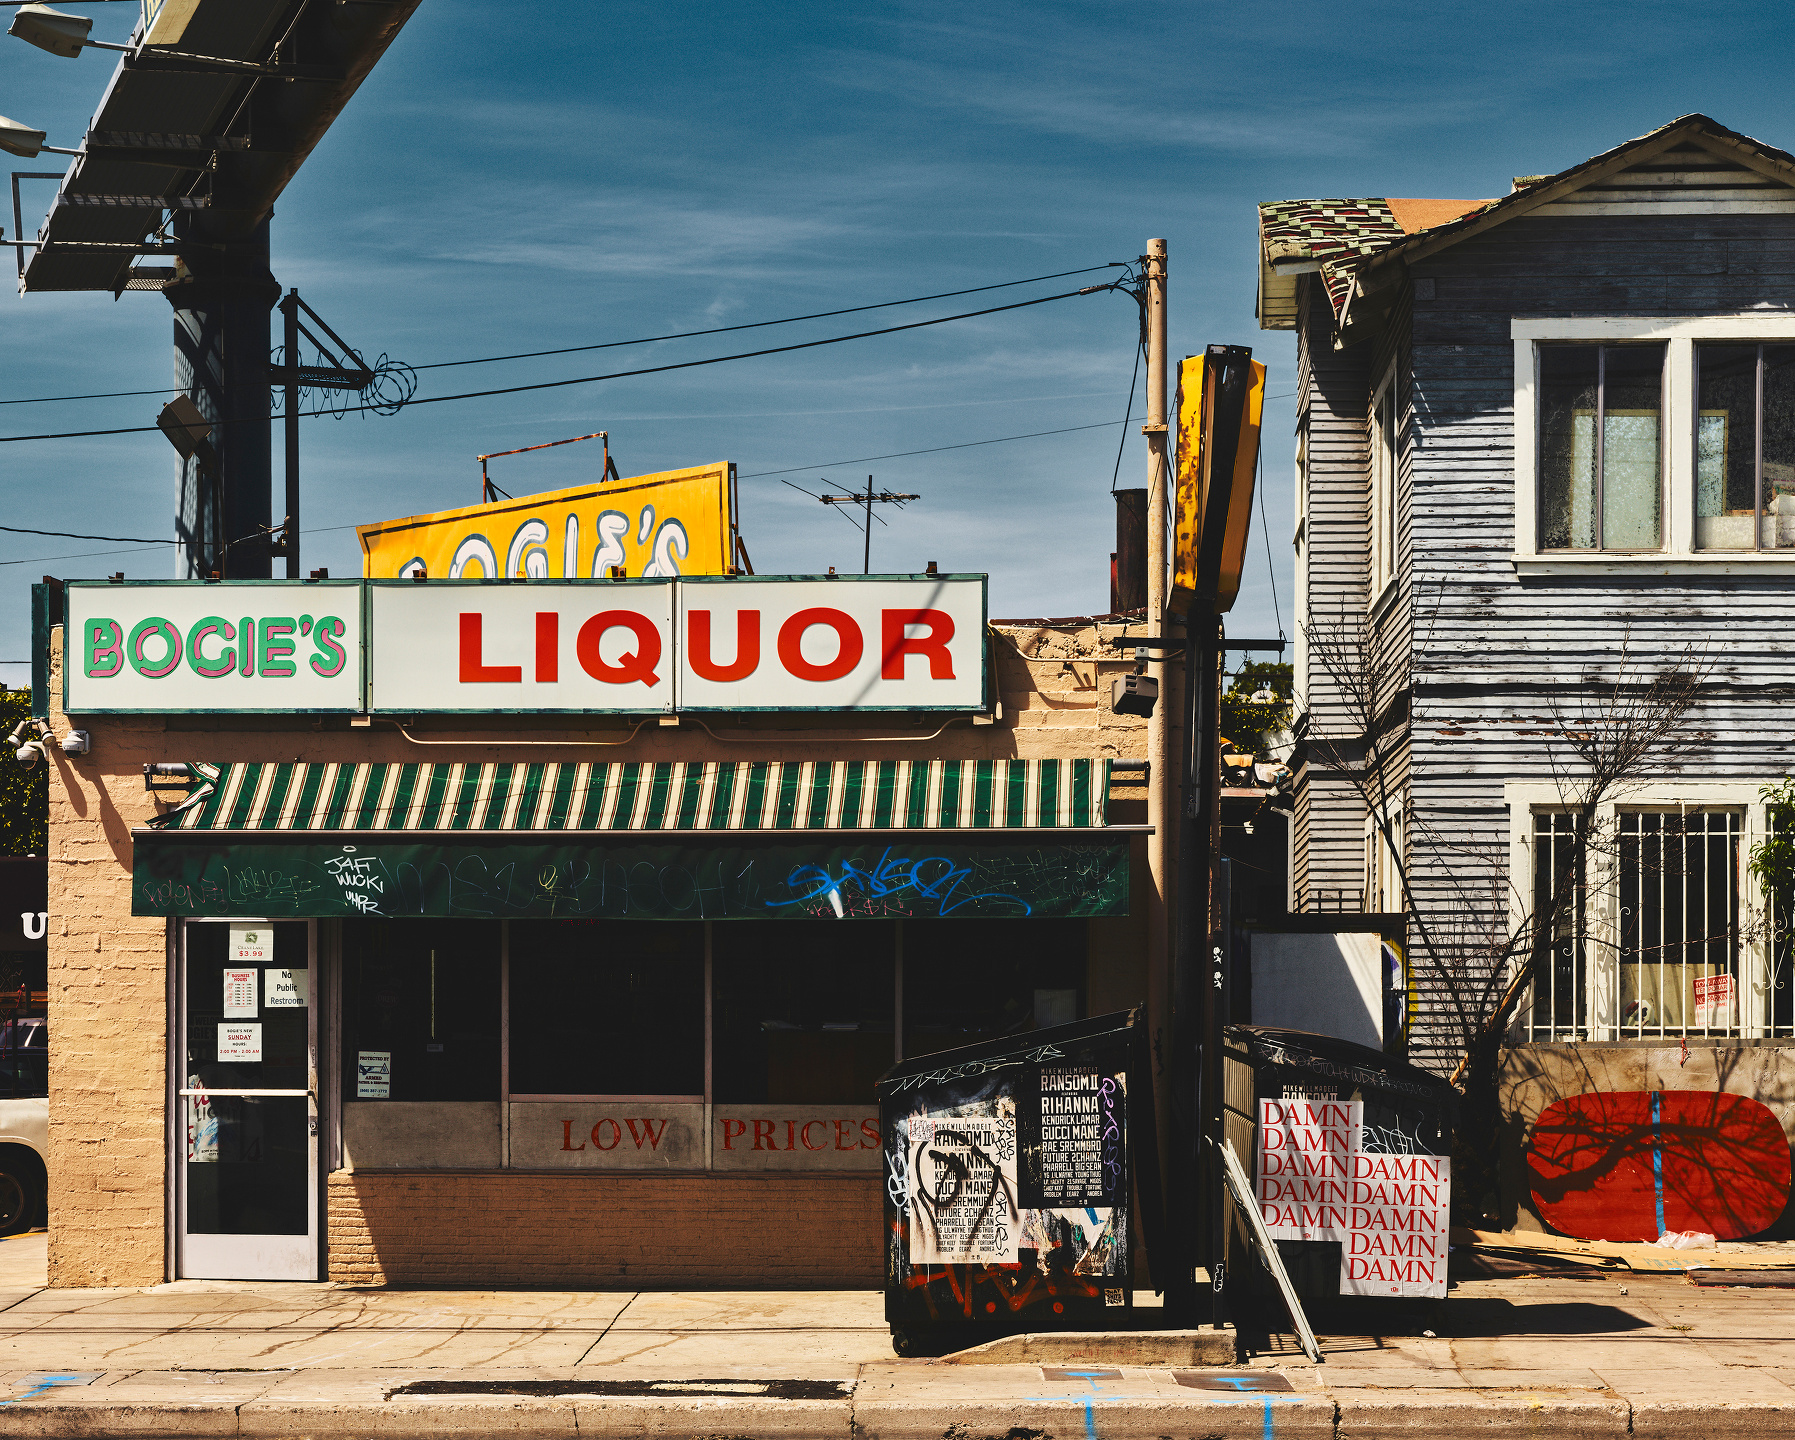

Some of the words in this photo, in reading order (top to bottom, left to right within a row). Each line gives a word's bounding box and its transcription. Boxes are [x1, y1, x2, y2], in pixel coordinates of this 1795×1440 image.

[399, 504, 689, 579] OGIE'S
[84, 613, 349, 680] BOGIE'S
[459, 607, 957, 688] LIQUOR
[281, 970, 292, 979] No
[276, 983, 298, 992] Public
[270, 996, 304, 1005] Restroom
[1041, 1096, 1099, 1114] RIHANNA
[1263, 1102, 1359, 1128] DAMN.
[1041, 1115, 1076, 1126] KENDRICK
[1076, 1114, 1100, 1125] LAMAR
[559, 1117, 667, 1151] LOW
[719, 1117, 882, 1151] PRICES
[1042, 1126, 1070, 1140] GUCCI
[1072, 1125, 1101, 1139] MANE
[1263, 1128, 1359, 1153] DAMN.
[1042, 1141, 1058, 1152] RAE
[1059, 1140, 1102, 1152] SREMMURD
[1042, 1152, 1070, 1163] FUTURE
[1071, 1151, 1102, 1162] 2CHAINZ
[1042, 1162, 1074, 1171] PHARRELL
[1352, 1156, 1448, 1183] DAMN.
[1351, 1182, 1447, 1208] DAMN.
[936, 1217, 966, 1227] PHARRELL
[1350, 1207, 1446, 1233] DAMN.
[1349, 1232, 1445, 1258] DAMN.
[1348, 1258, 1444, 1284] DAMN.
